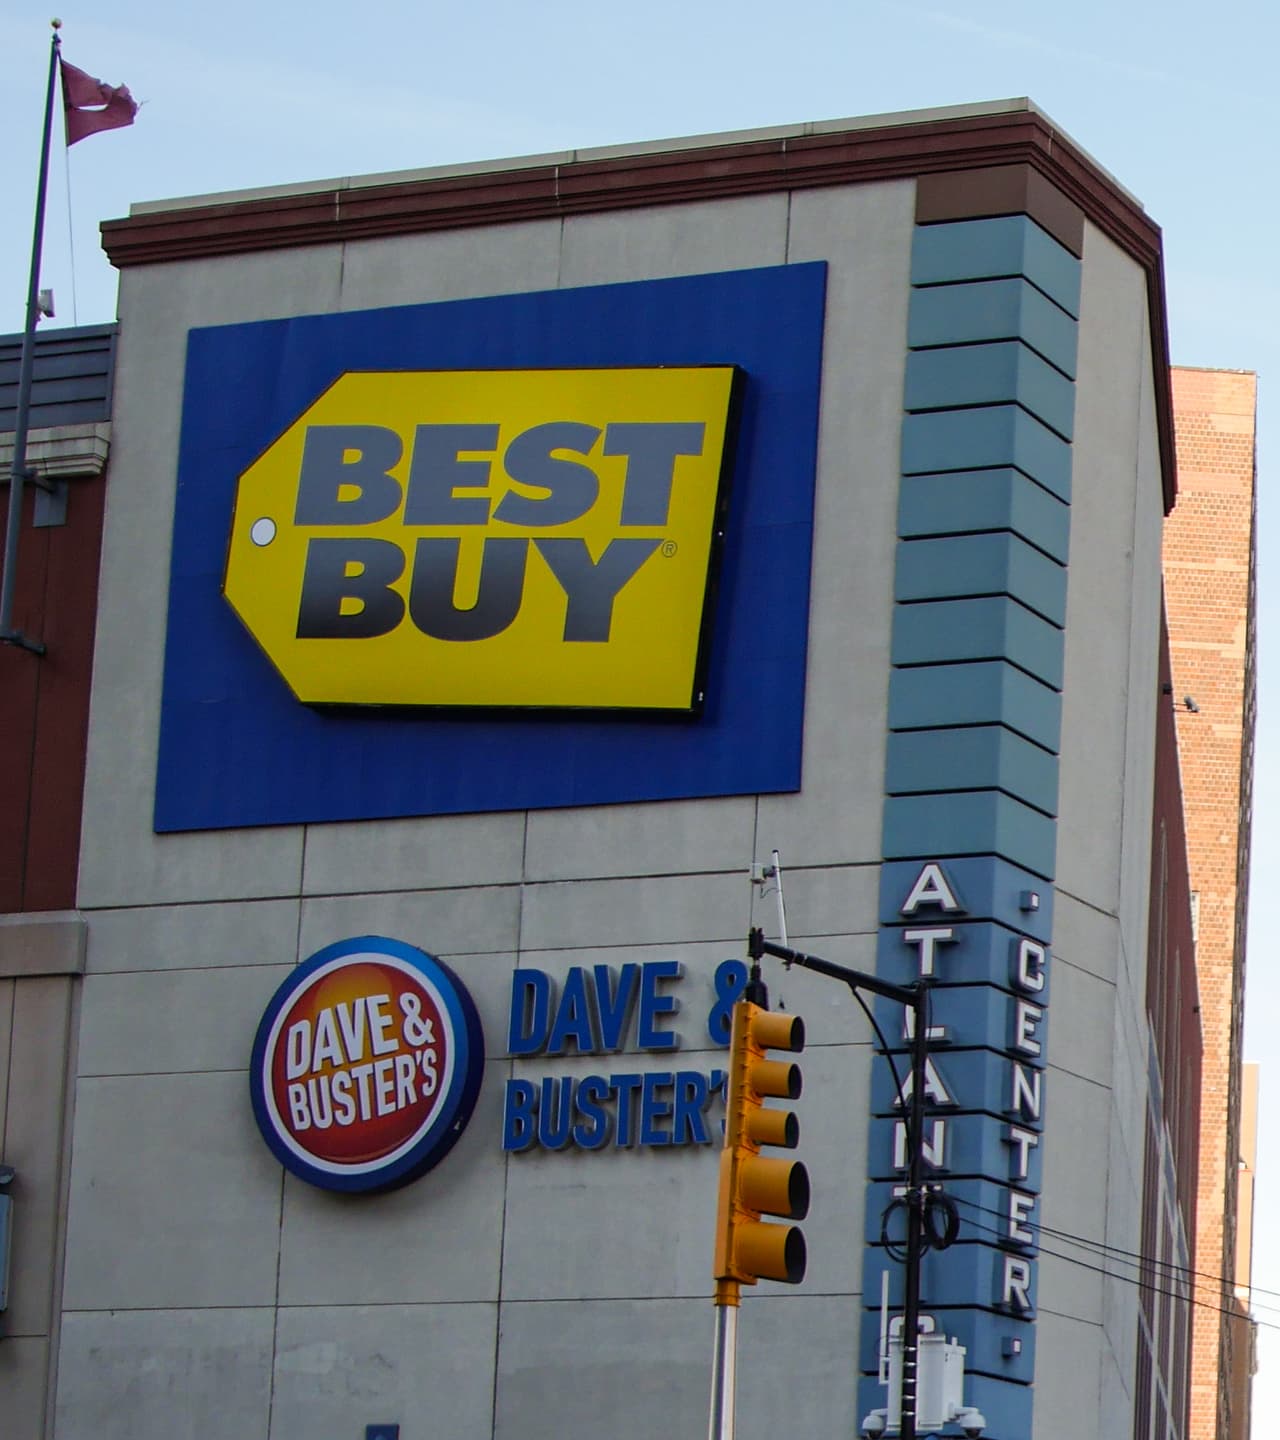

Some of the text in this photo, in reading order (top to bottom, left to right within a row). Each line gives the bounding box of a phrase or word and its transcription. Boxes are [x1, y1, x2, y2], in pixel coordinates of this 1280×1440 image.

[293, 421, 706, 528] BEST
[296, 537, 664, 643] BUY
[287, 992, 436, 1080] DAVE &
[508, 959, 749, 1055] DAVE &
[288, 1048, 438, 1131] BUSTER'S
[504, 1069, 728, 1152] BUSTER'
[1004, 938, 1046, 1308] CENTER
